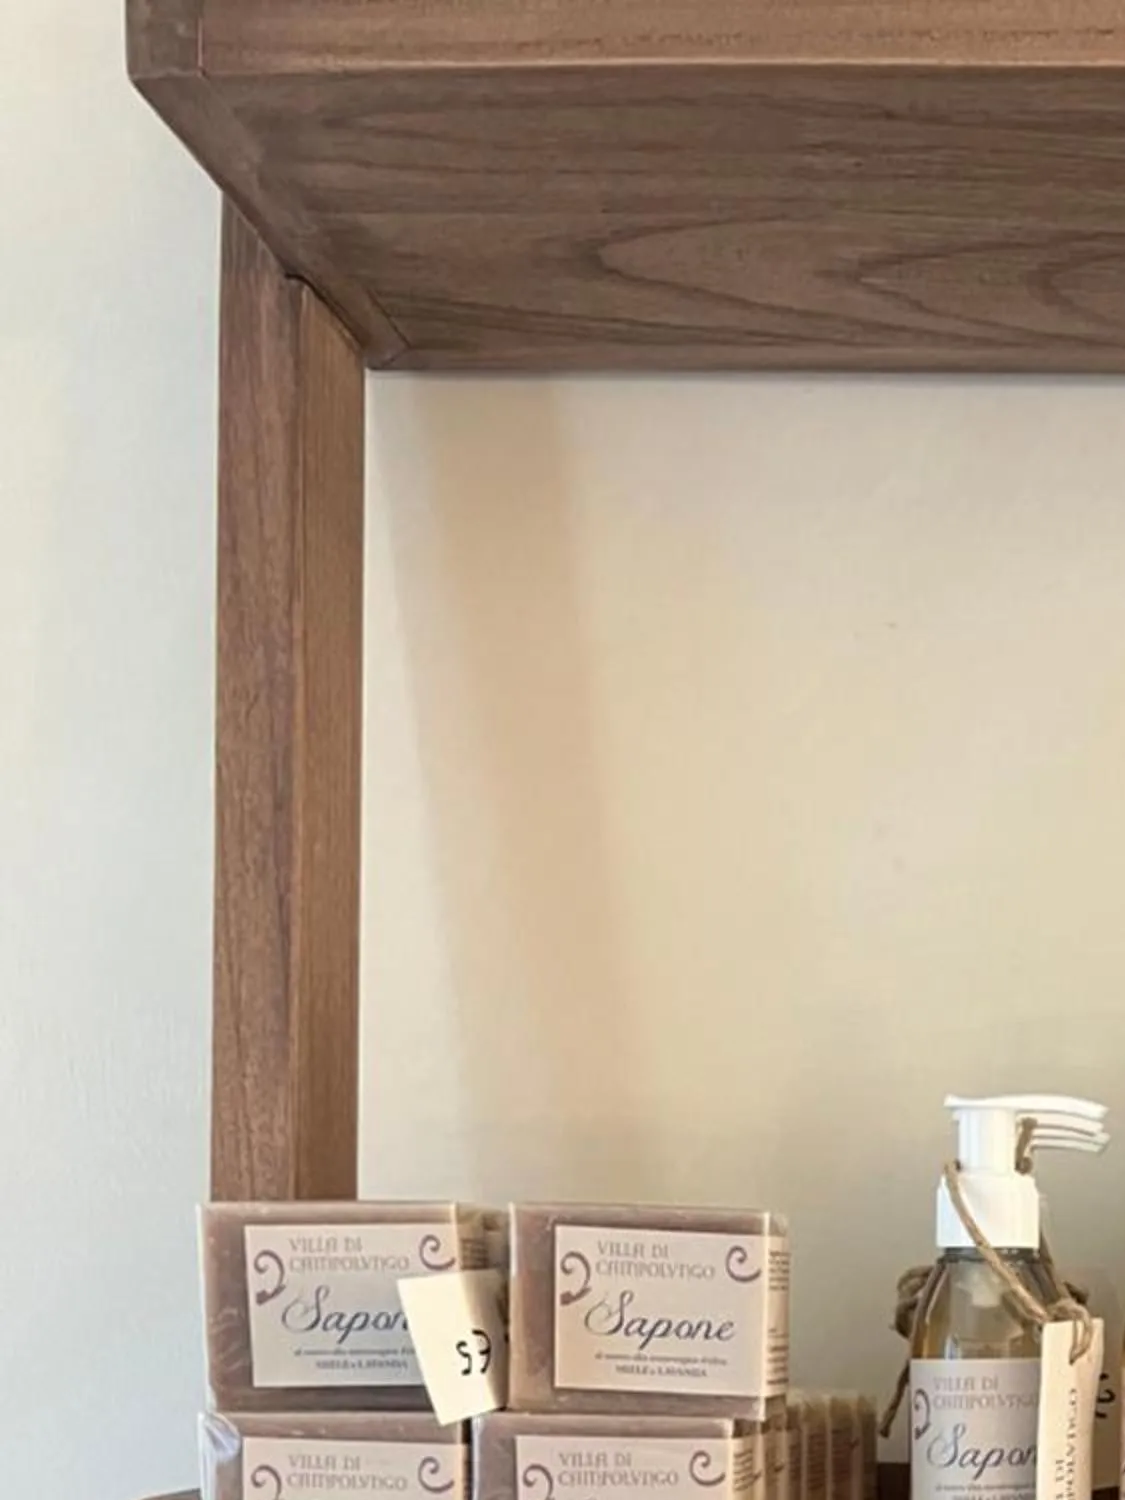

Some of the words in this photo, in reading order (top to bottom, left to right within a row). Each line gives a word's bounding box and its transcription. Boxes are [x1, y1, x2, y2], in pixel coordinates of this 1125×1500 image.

[281, 1284, 408, 1345] Sapon
[584, 1289, 735, 1350] Sapone
[926, 1422, 1038, 1481] Sapon
